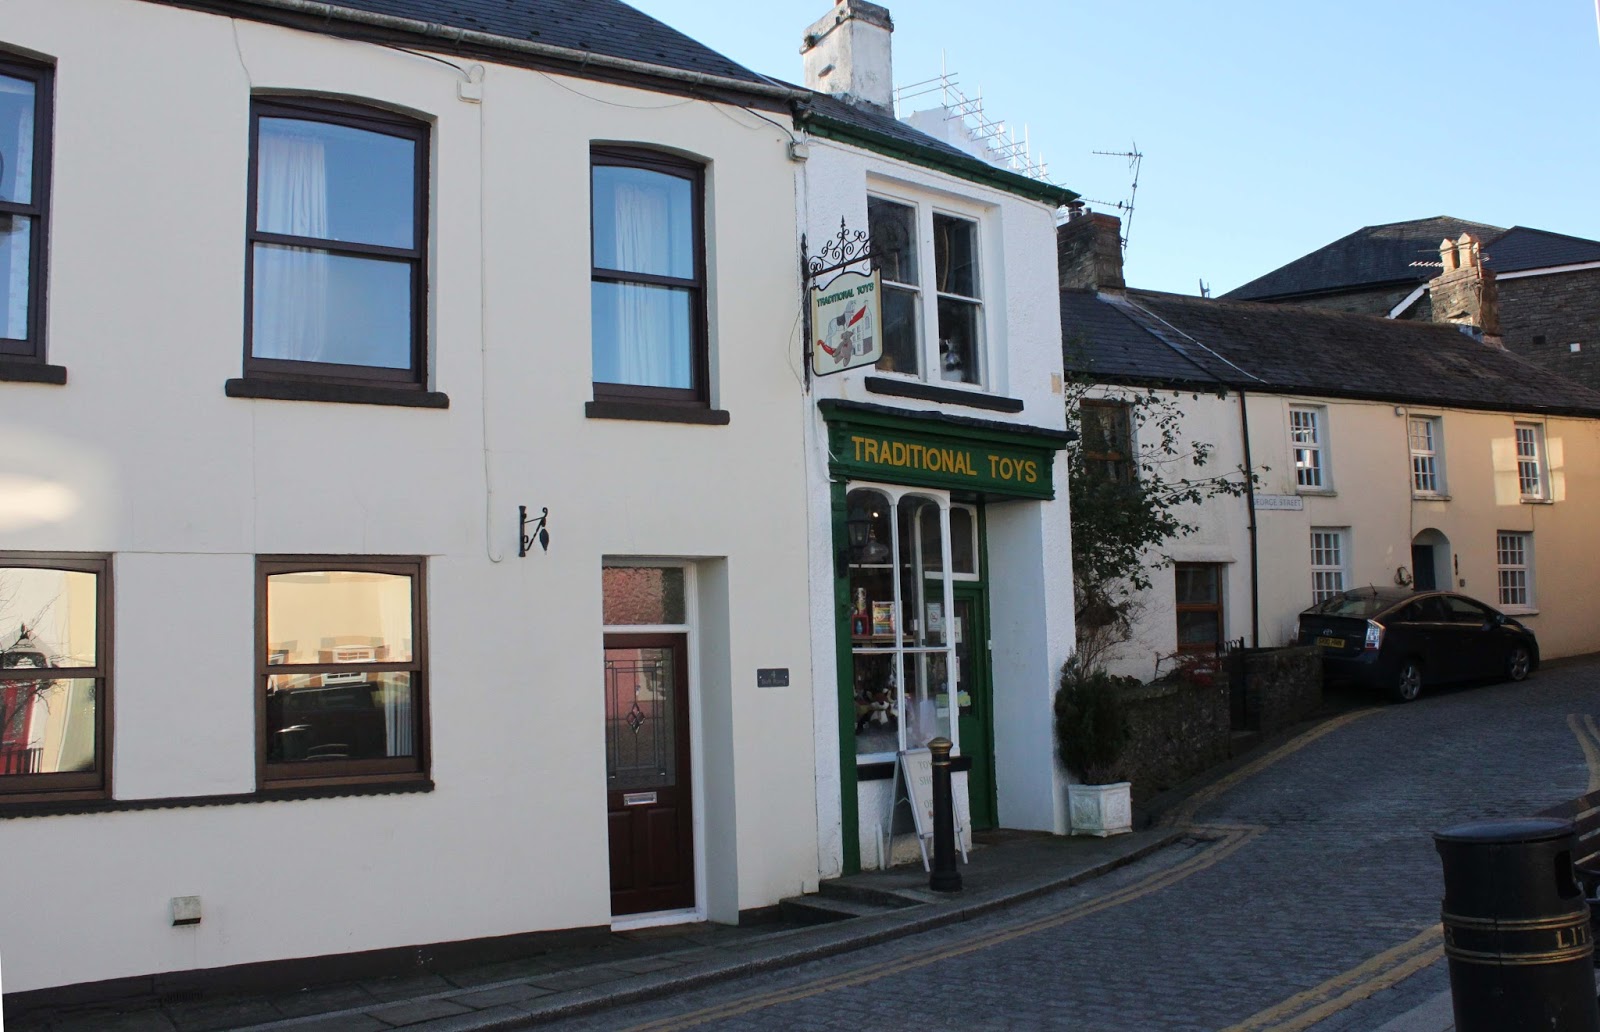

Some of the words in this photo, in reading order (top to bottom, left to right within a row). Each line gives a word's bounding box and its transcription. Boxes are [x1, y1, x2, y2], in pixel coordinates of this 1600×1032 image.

[816, 288, 854, 307] TRADITIONAL
[856, 282, 875, 296] TOYS
[851, 436, 977, 476] TRADITIONAL
[987, 455, 1038, 483] TOYS
[1279, 498, 1301, 507] STREET
